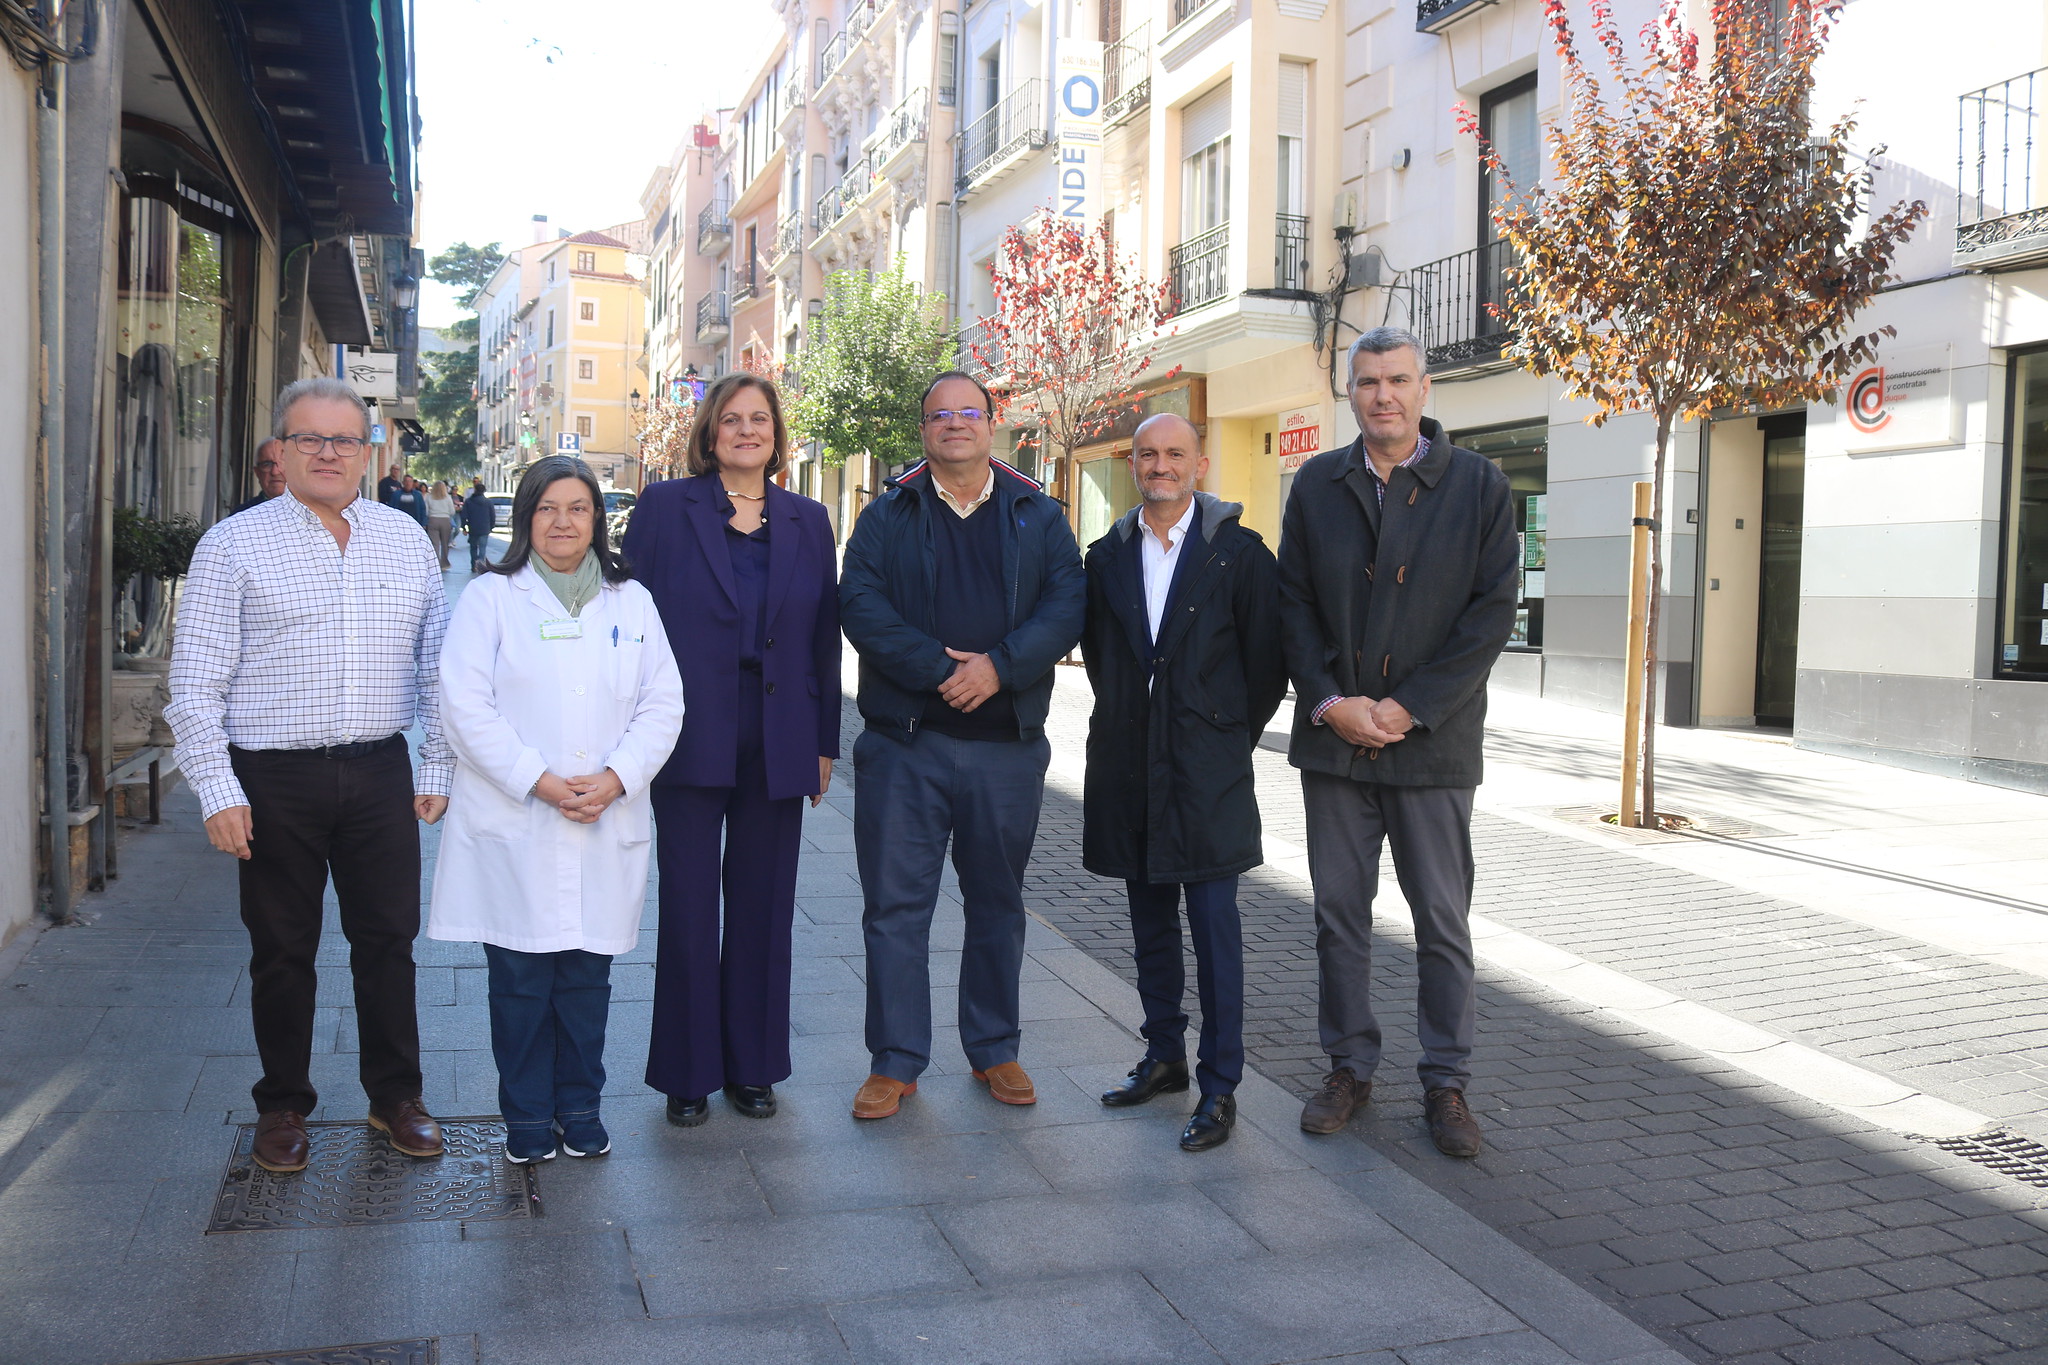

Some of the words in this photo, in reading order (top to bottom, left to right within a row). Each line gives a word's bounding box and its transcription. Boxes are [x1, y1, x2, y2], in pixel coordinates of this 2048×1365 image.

[1885, 367, 1941, 380] construcciones
[1886, 384, 1891, 393] y
[1892, 380, 1927, 391] contratas
[1884, 393, 1907, 403] duque
[1286, 413, 1305, 426] estilo
[1281, 433, 1291, 453] 949
[1292, 431, 1299, 452] 21
[1301, 430, 1308, 450] 41
[1310, 428, 1319, 449] 04
[1285, 453, 1314, 468] ALQUIL
